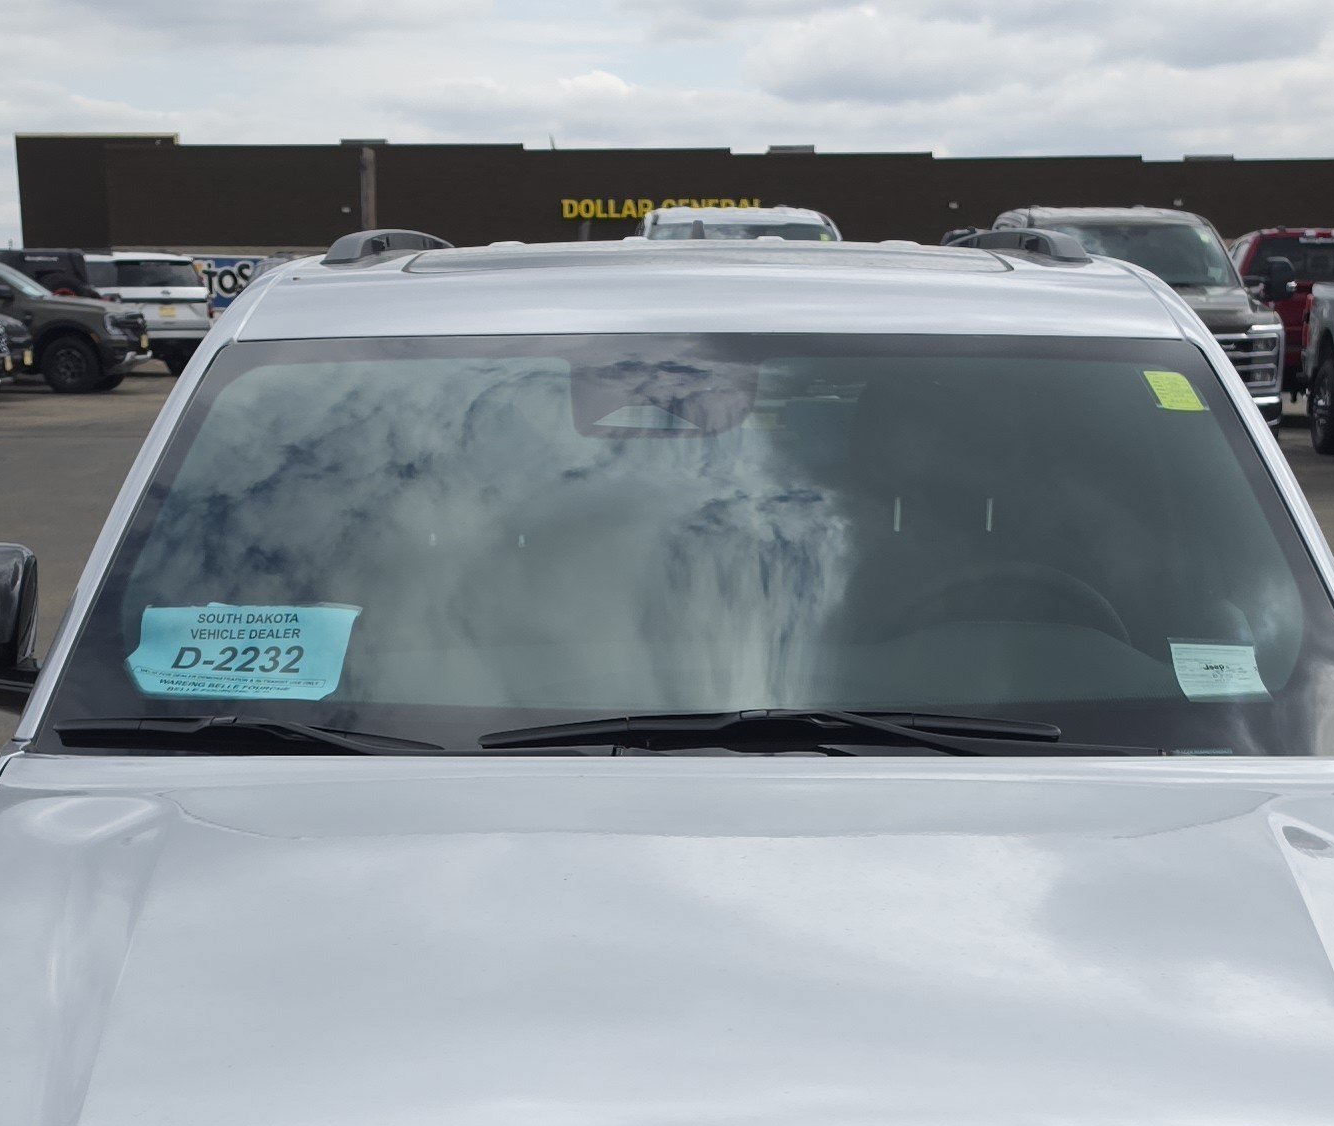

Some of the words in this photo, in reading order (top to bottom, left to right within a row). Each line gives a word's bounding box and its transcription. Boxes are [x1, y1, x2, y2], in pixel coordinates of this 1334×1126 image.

[562, 198, 654, 218] DOLLAR
[197, 613, 241, 624] SOUTH
[246, 613, 299, 624] DAKOTA
[191, 628, 246, 640] VEHICLE
[249, 628, 300, 640] DEALER
[170, 645, 305, 674] D-2232
[159, 679, 206, 687] WAREING
